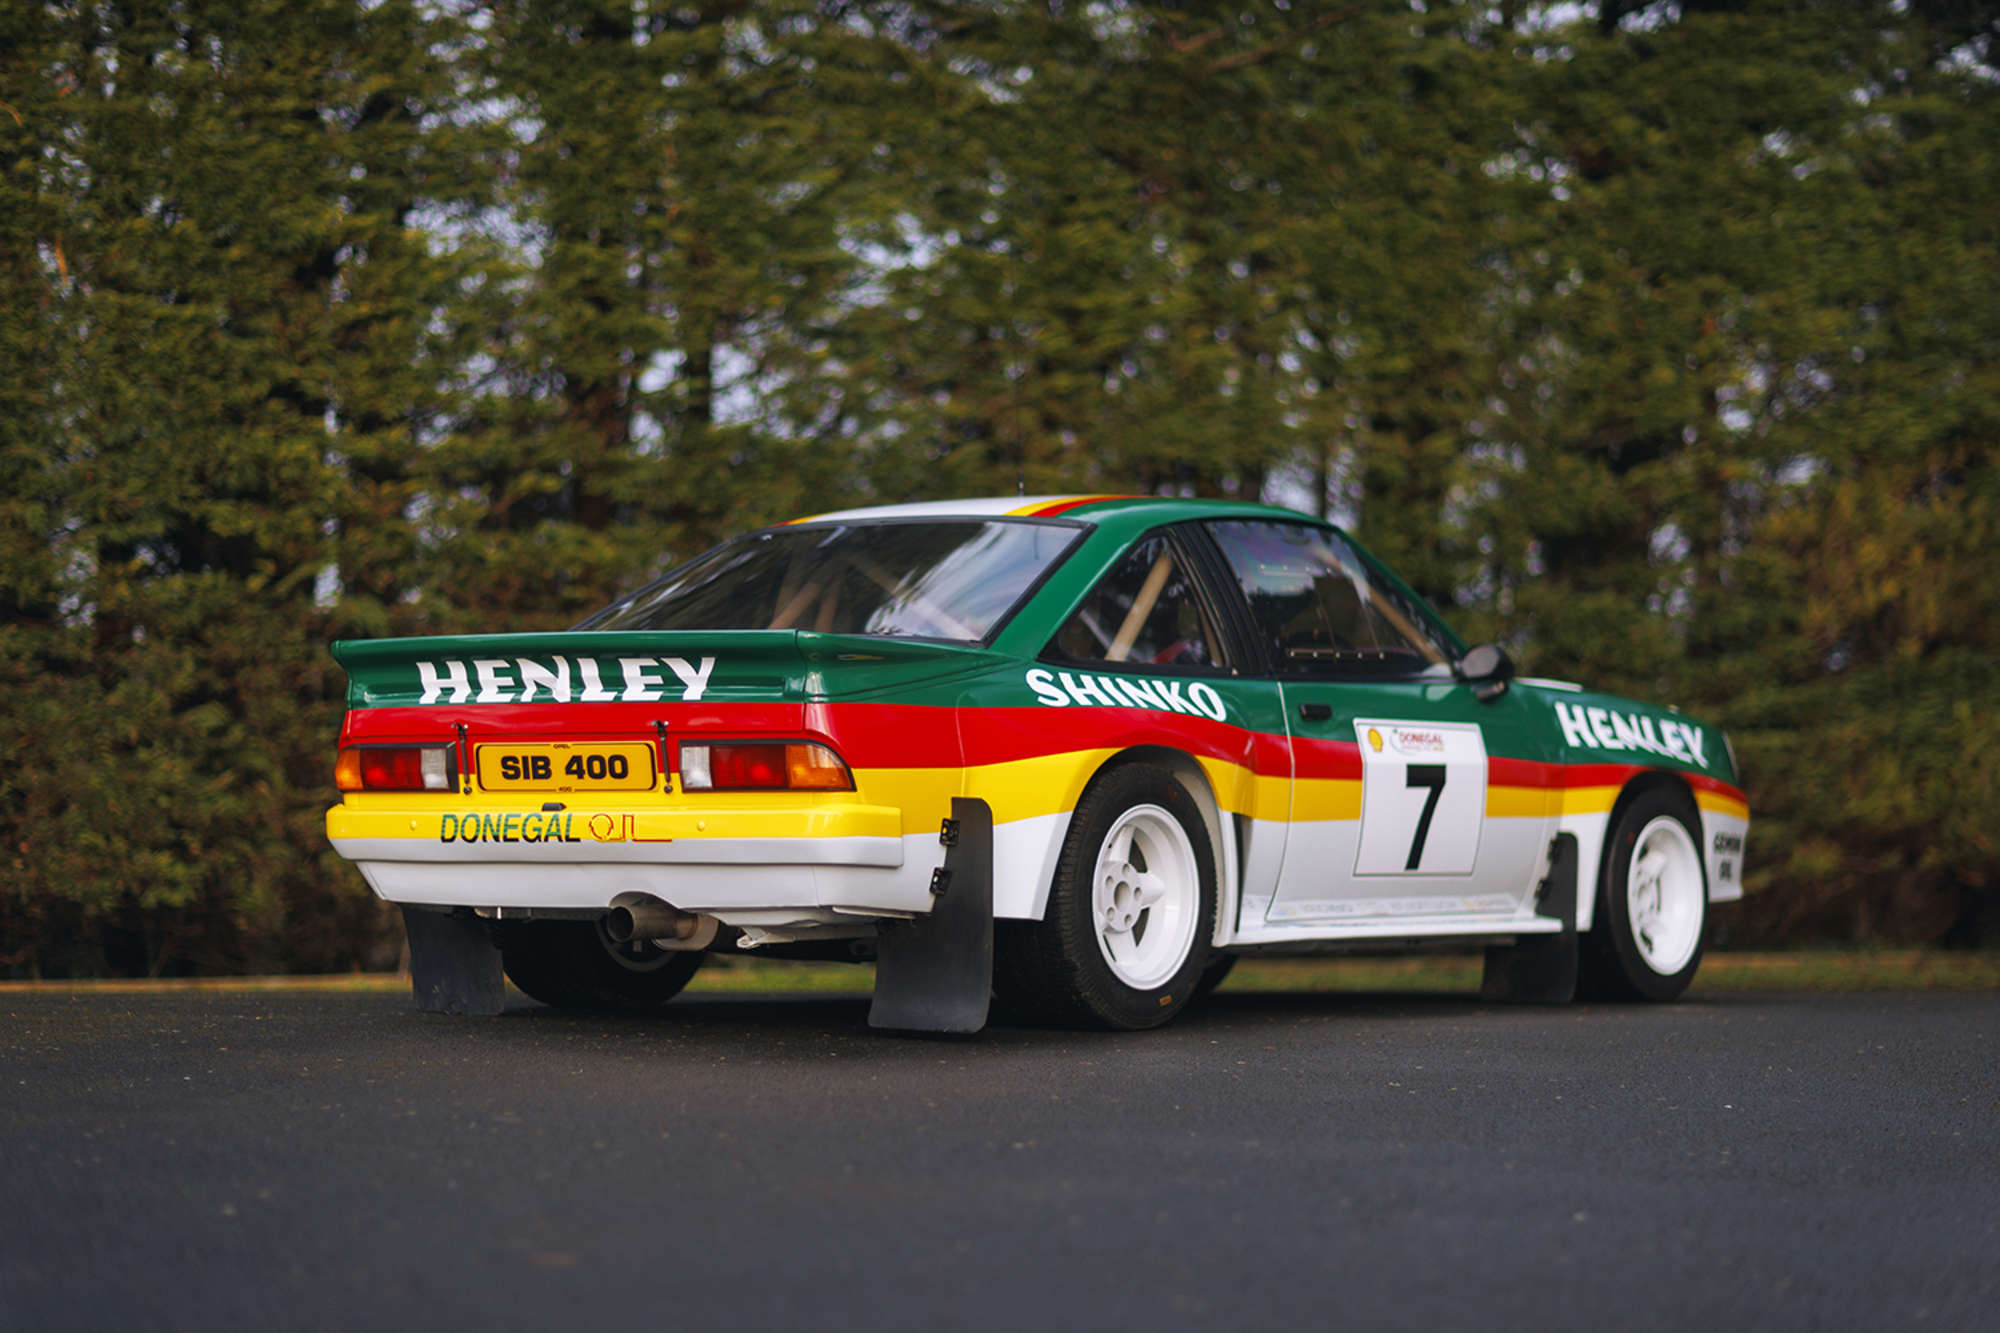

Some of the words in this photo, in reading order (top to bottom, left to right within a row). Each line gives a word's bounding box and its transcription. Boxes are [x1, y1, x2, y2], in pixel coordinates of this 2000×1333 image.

[416, 655, 716, 704] HENLEY
[1025, 668, 1227, 722] SHINKO
[1554, 701, 1709, 769] HENLEY
[501, 755, 552, 780] SIB
[565, 754, 628, 780] 400
[440, 813, 581, 843] DONEGAL
[1405, 764, 1446, 870] 7
